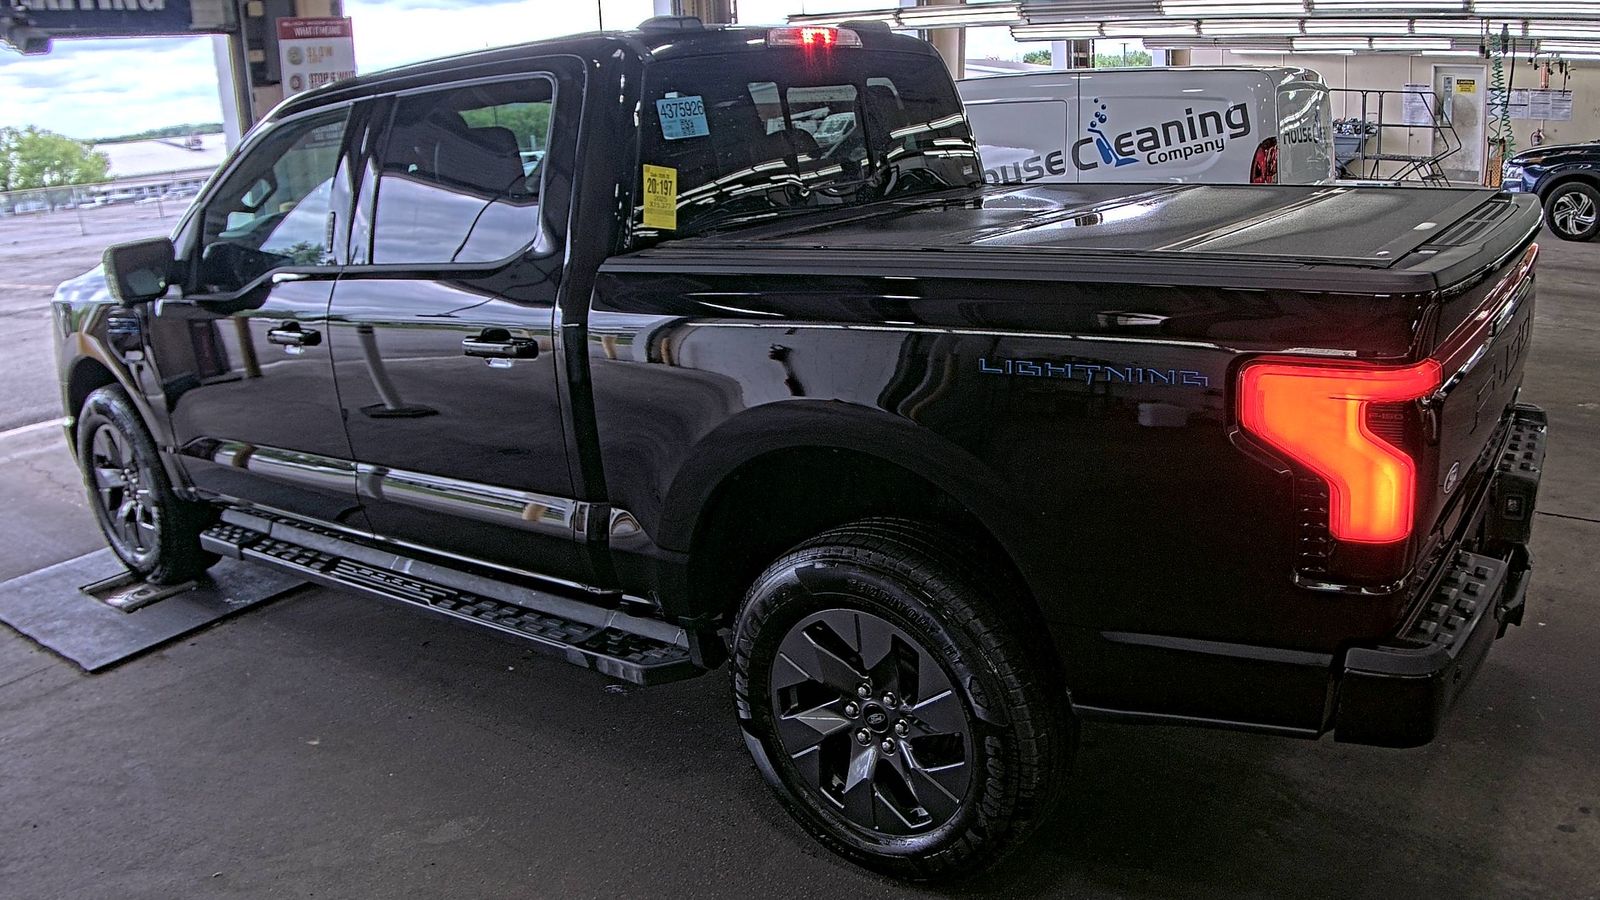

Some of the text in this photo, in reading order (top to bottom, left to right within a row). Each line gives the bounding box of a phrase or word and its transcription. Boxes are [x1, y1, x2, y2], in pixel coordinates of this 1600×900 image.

[660, 100, 705, 119] 4375926
[984, 102, 1251, 184] ouse Cleaning
[1146, 138, 1225, 166] Company
[646, 177, 673, 197] 20:197
[978, 358, 1209, 388] LIGHTNING
